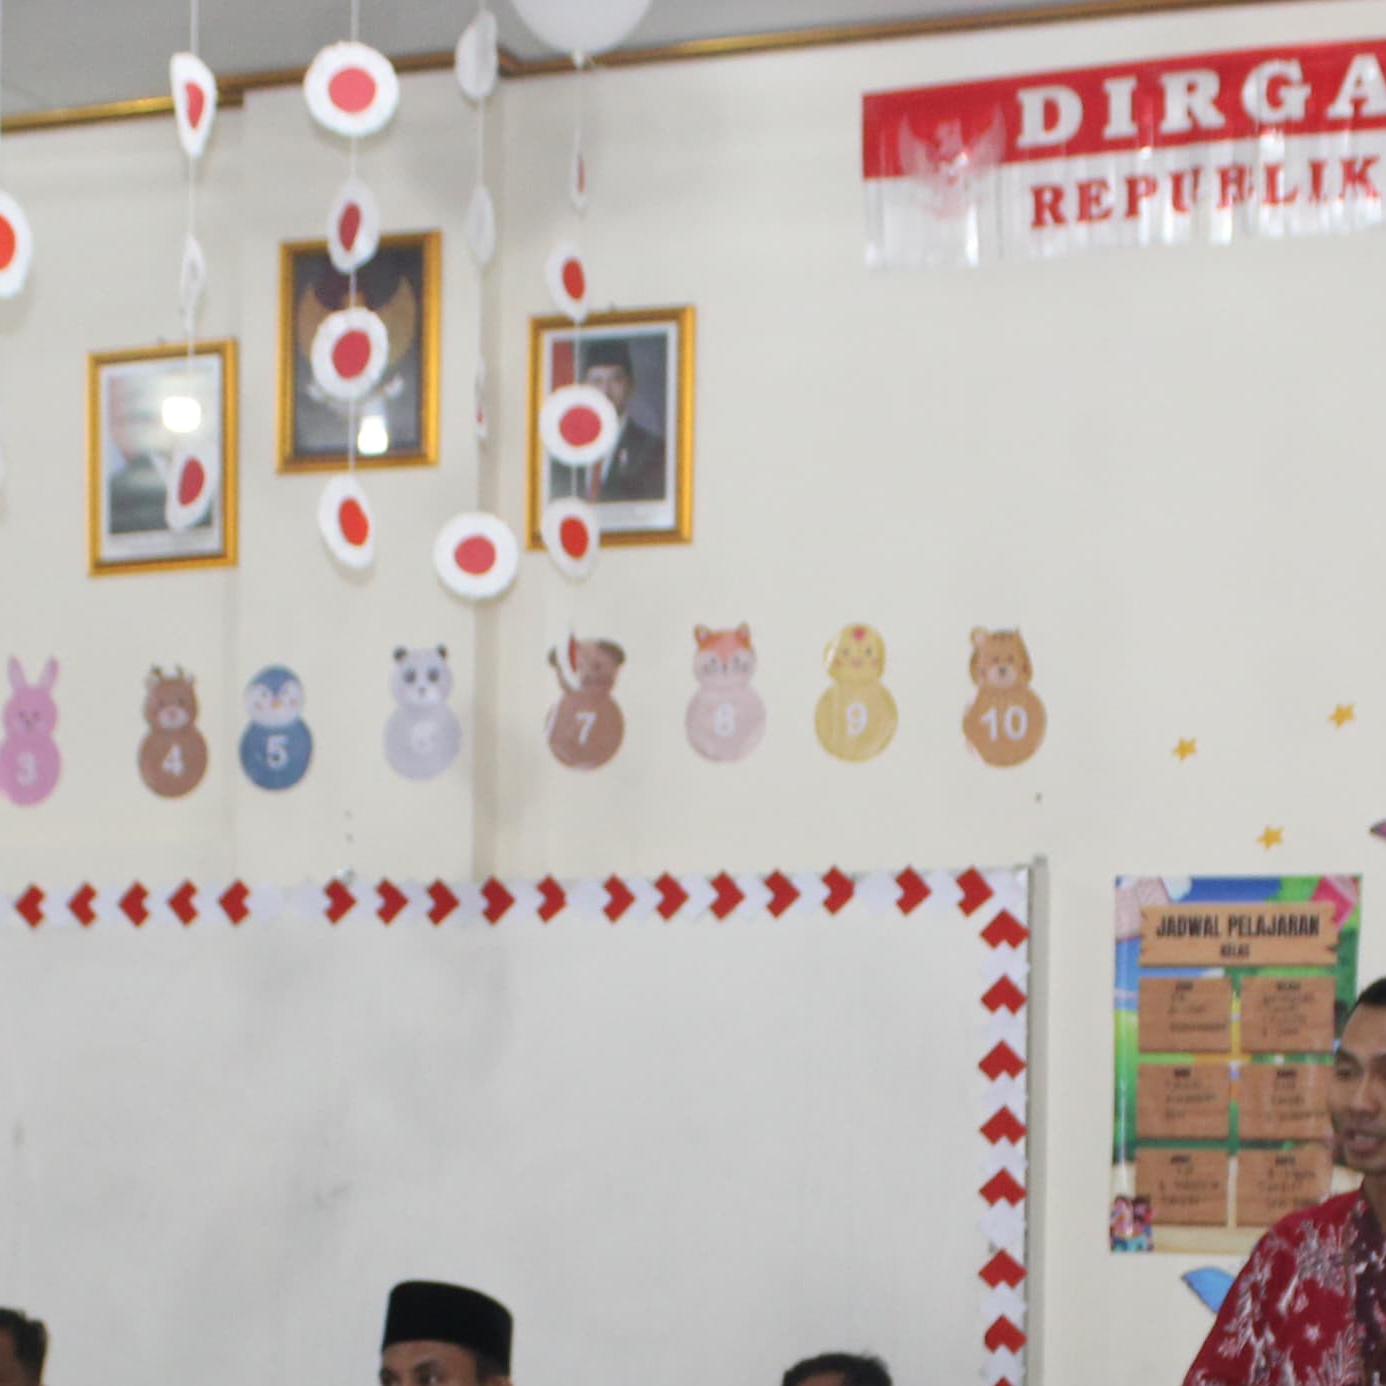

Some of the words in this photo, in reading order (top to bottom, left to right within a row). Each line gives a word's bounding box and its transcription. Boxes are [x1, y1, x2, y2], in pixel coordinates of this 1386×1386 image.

[1031, 153, 1382, 229] REPUBLIK
[575, 711, 598, 744] 7
[714, 704, 736, 737] 8
[845, 701, 869, 737] 9
[979, 704, 1030, 741] 10
[162, 743, 185, 777] 4
[265, 735, 289, 768] 5
[17, 753, 37, 787] 3
[1156, 914, 1221, 938] JADWAL
[1227, 914, 1320, 938] PELAJARAN
